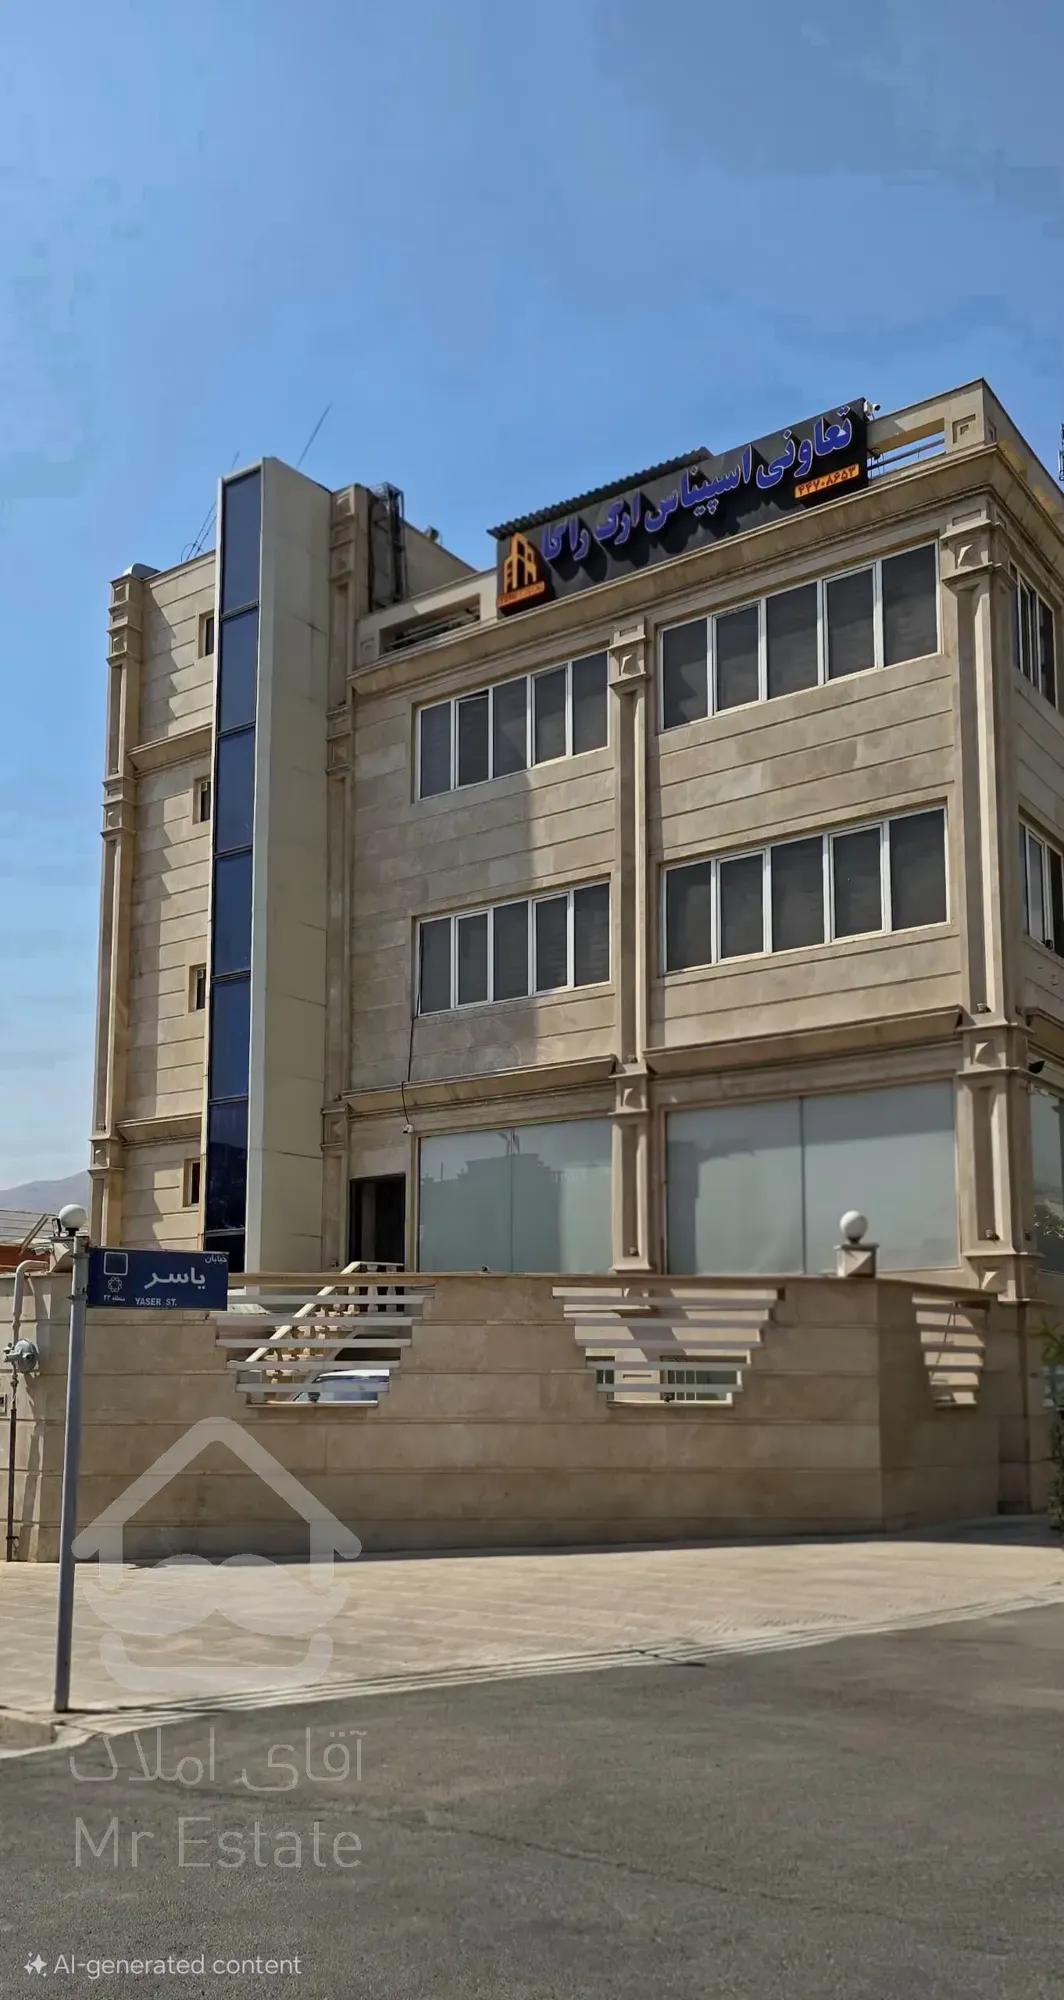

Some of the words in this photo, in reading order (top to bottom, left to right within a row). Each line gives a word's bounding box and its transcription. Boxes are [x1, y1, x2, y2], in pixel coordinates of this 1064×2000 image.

[756, 406, 852, 489] تعاونی
[644, 444, 753, 533] اسپیناس
[204, 1253, 228, 1264] خیابان
[144, 1267, 206, 1290] یاسر
[135, 1297, 162, 1306] YASER
[165, 1297, 178, 1307] ST.
